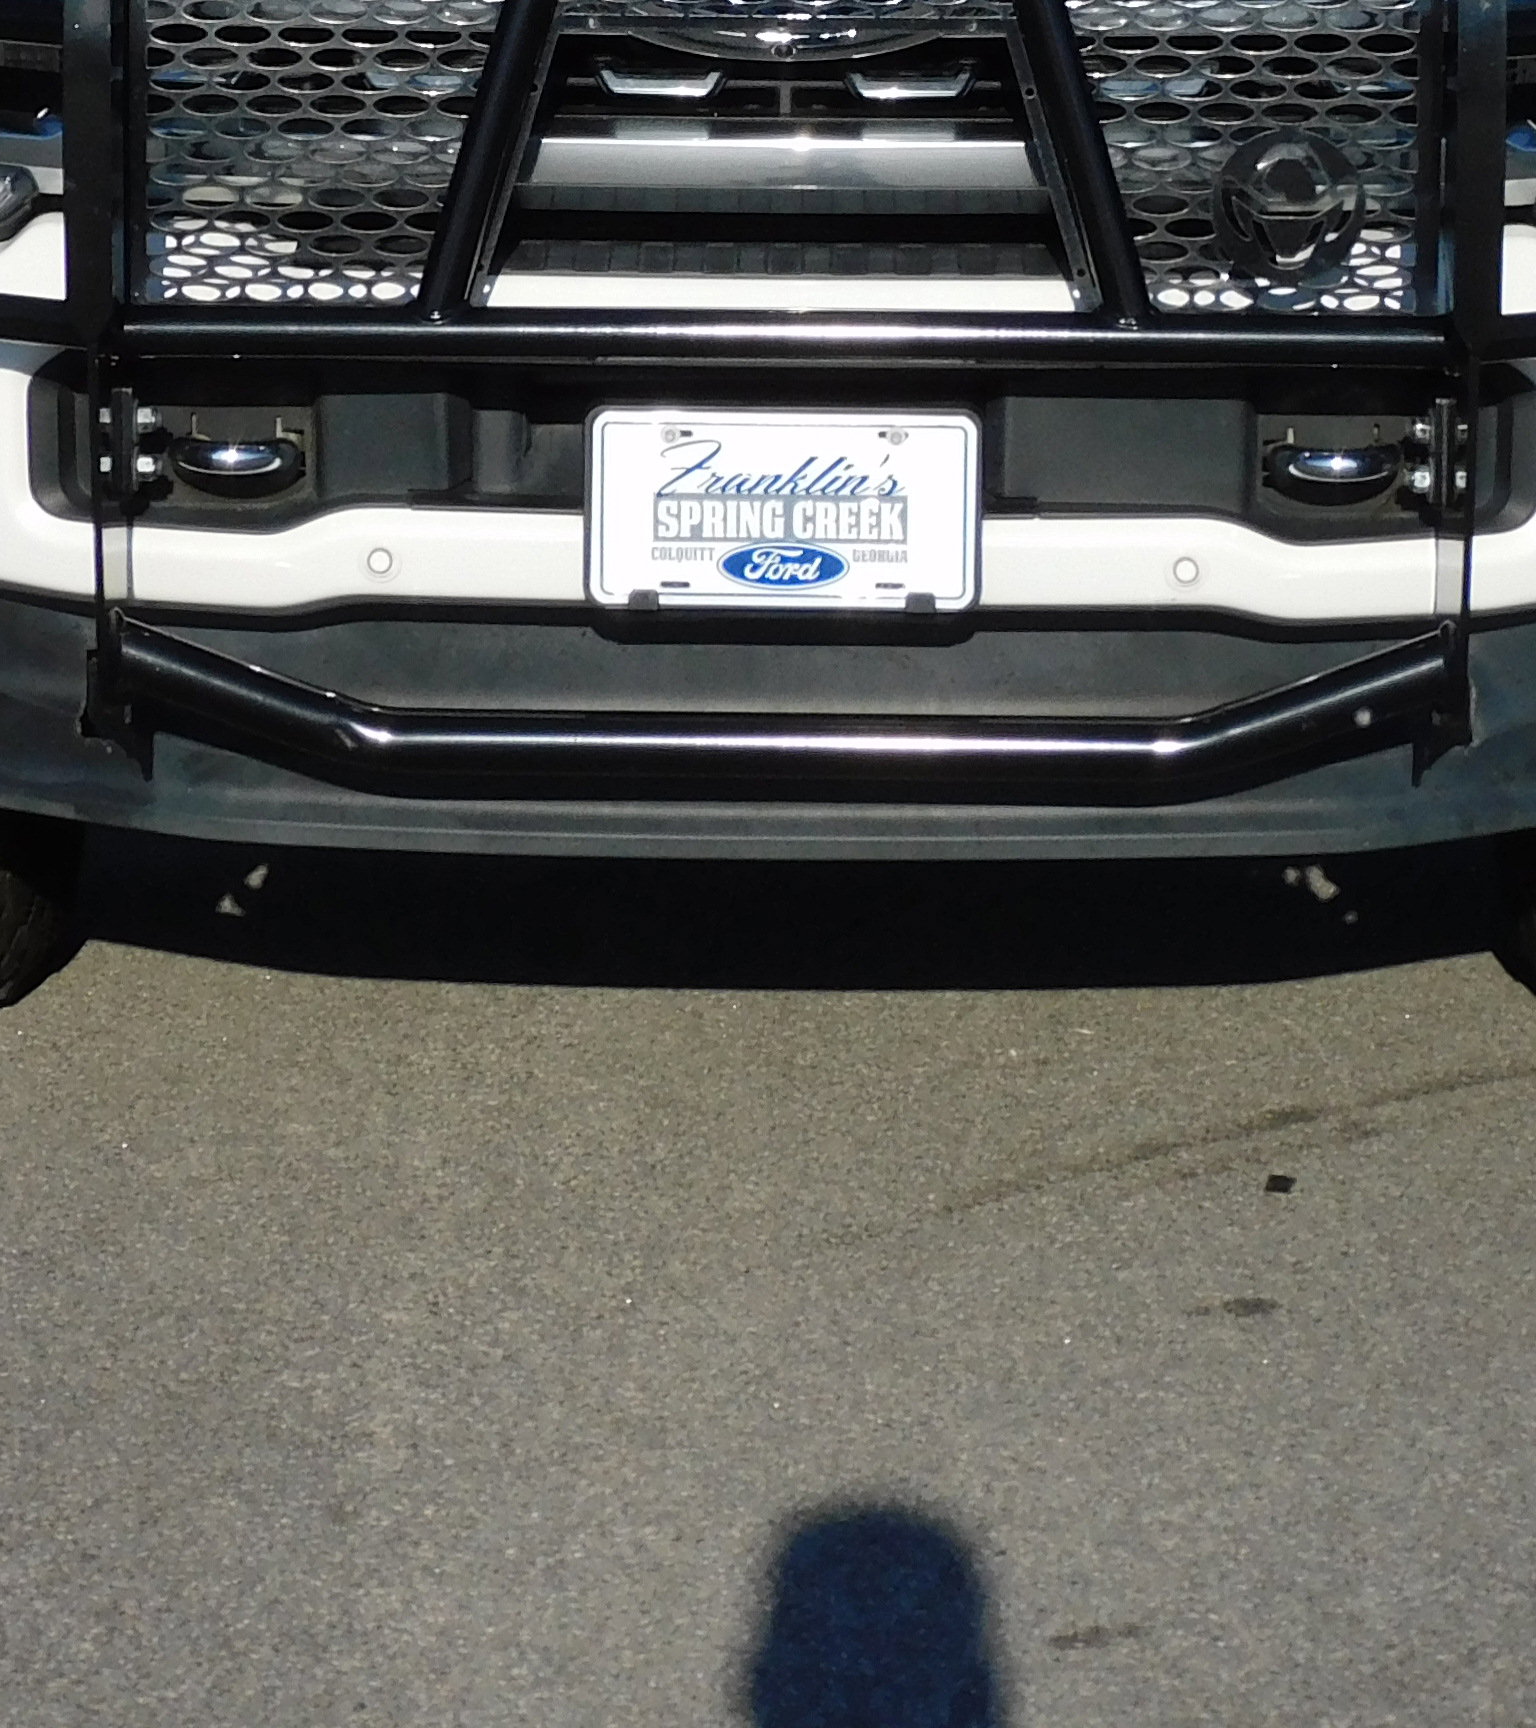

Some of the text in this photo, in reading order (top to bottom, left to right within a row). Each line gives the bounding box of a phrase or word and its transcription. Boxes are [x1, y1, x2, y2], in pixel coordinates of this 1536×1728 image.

[656, 439, 906, 498] Franklin's
[657, 498, 904, 540] SPRING CREEK
[651, 546, 908, 581] COLQUITT Ford GEORGIA
